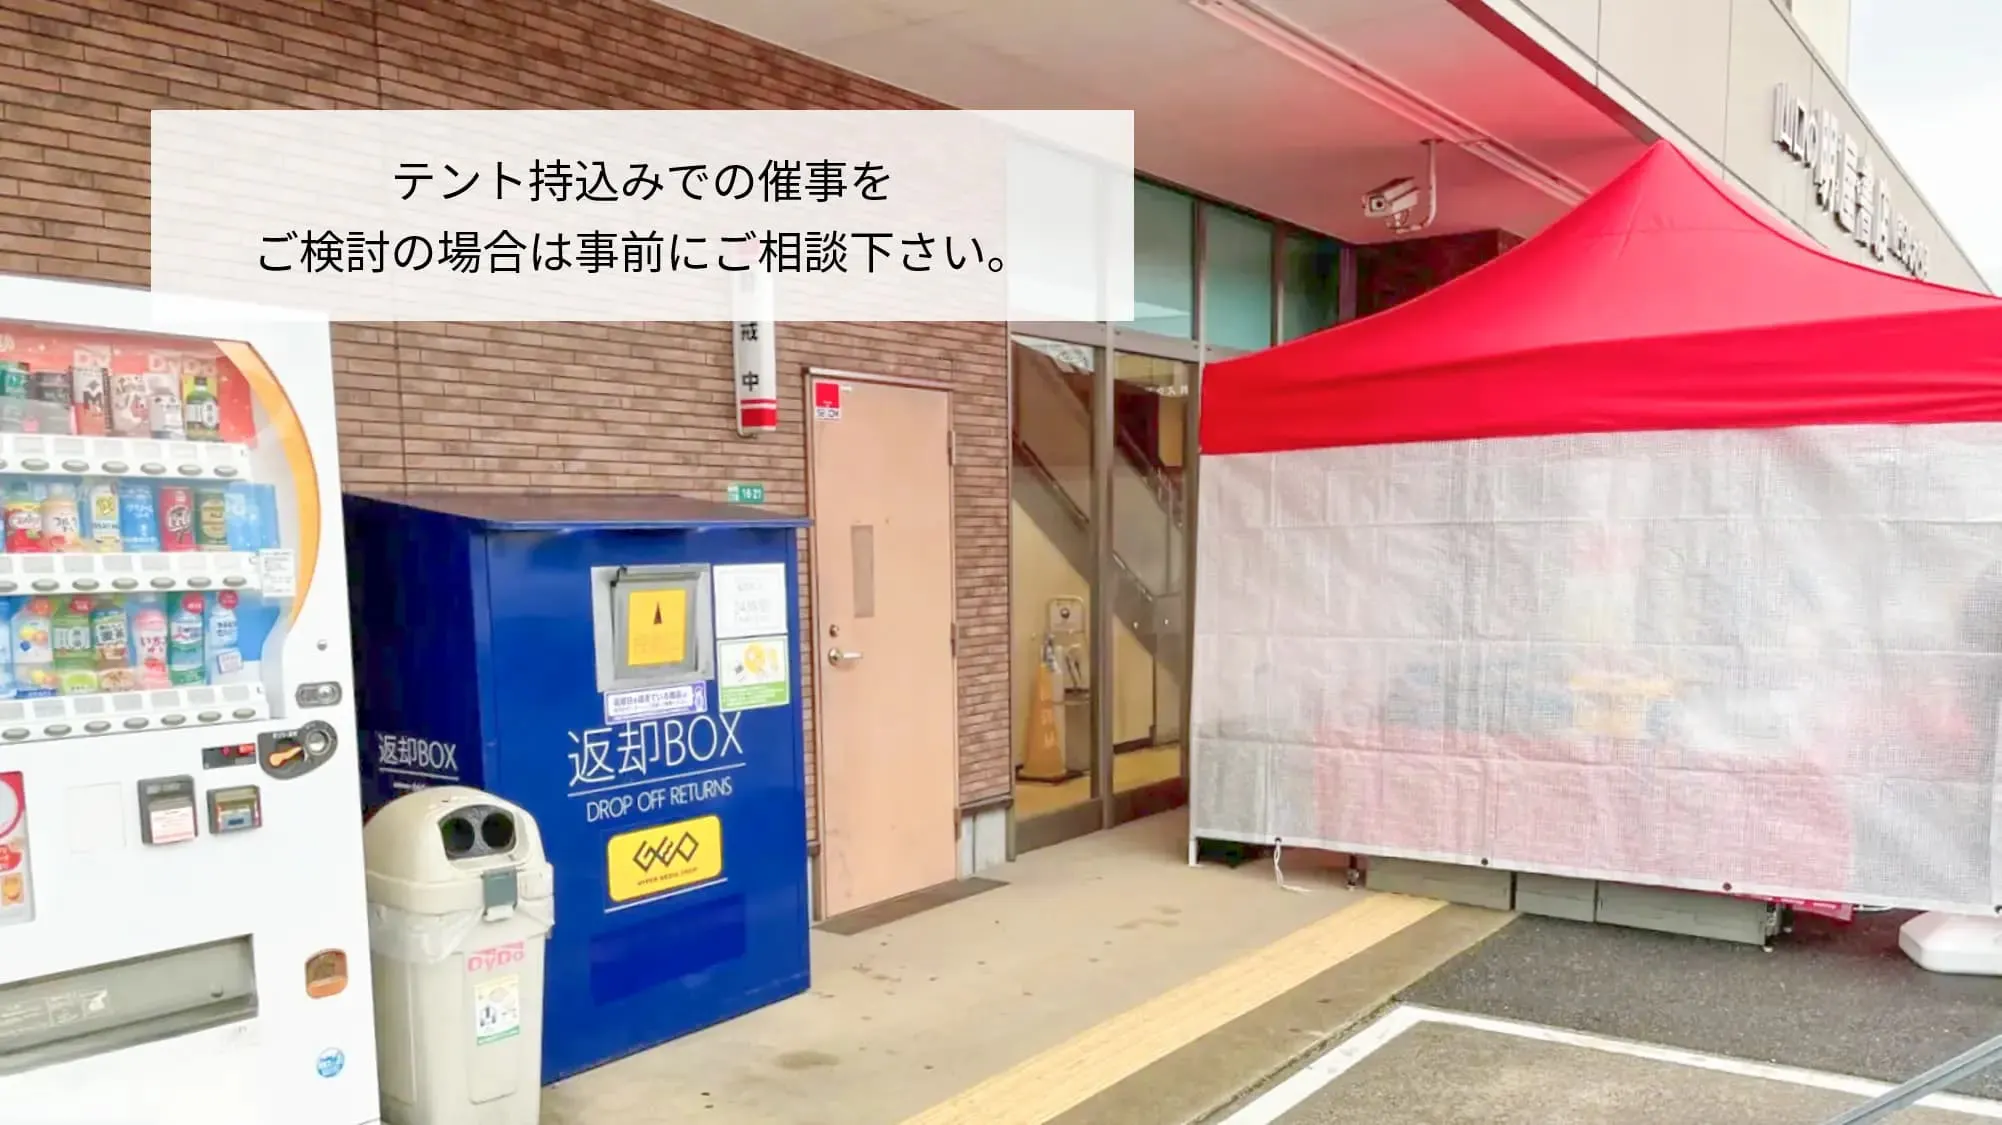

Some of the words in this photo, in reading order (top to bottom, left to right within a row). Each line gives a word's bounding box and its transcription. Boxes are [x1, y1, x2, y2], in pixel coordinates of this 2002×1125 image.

[376, 734, 459, 771] 返却BOX
[568, 711, 744, 787] 返却BOX
[586, 795, 632, 823] DROP
[637, 788, 666, 812] OFF
[670, 776, 733, 806] RETURNS
[632, 831, 699, 872] GEO
[468, 942, 525, 972] DyDo
